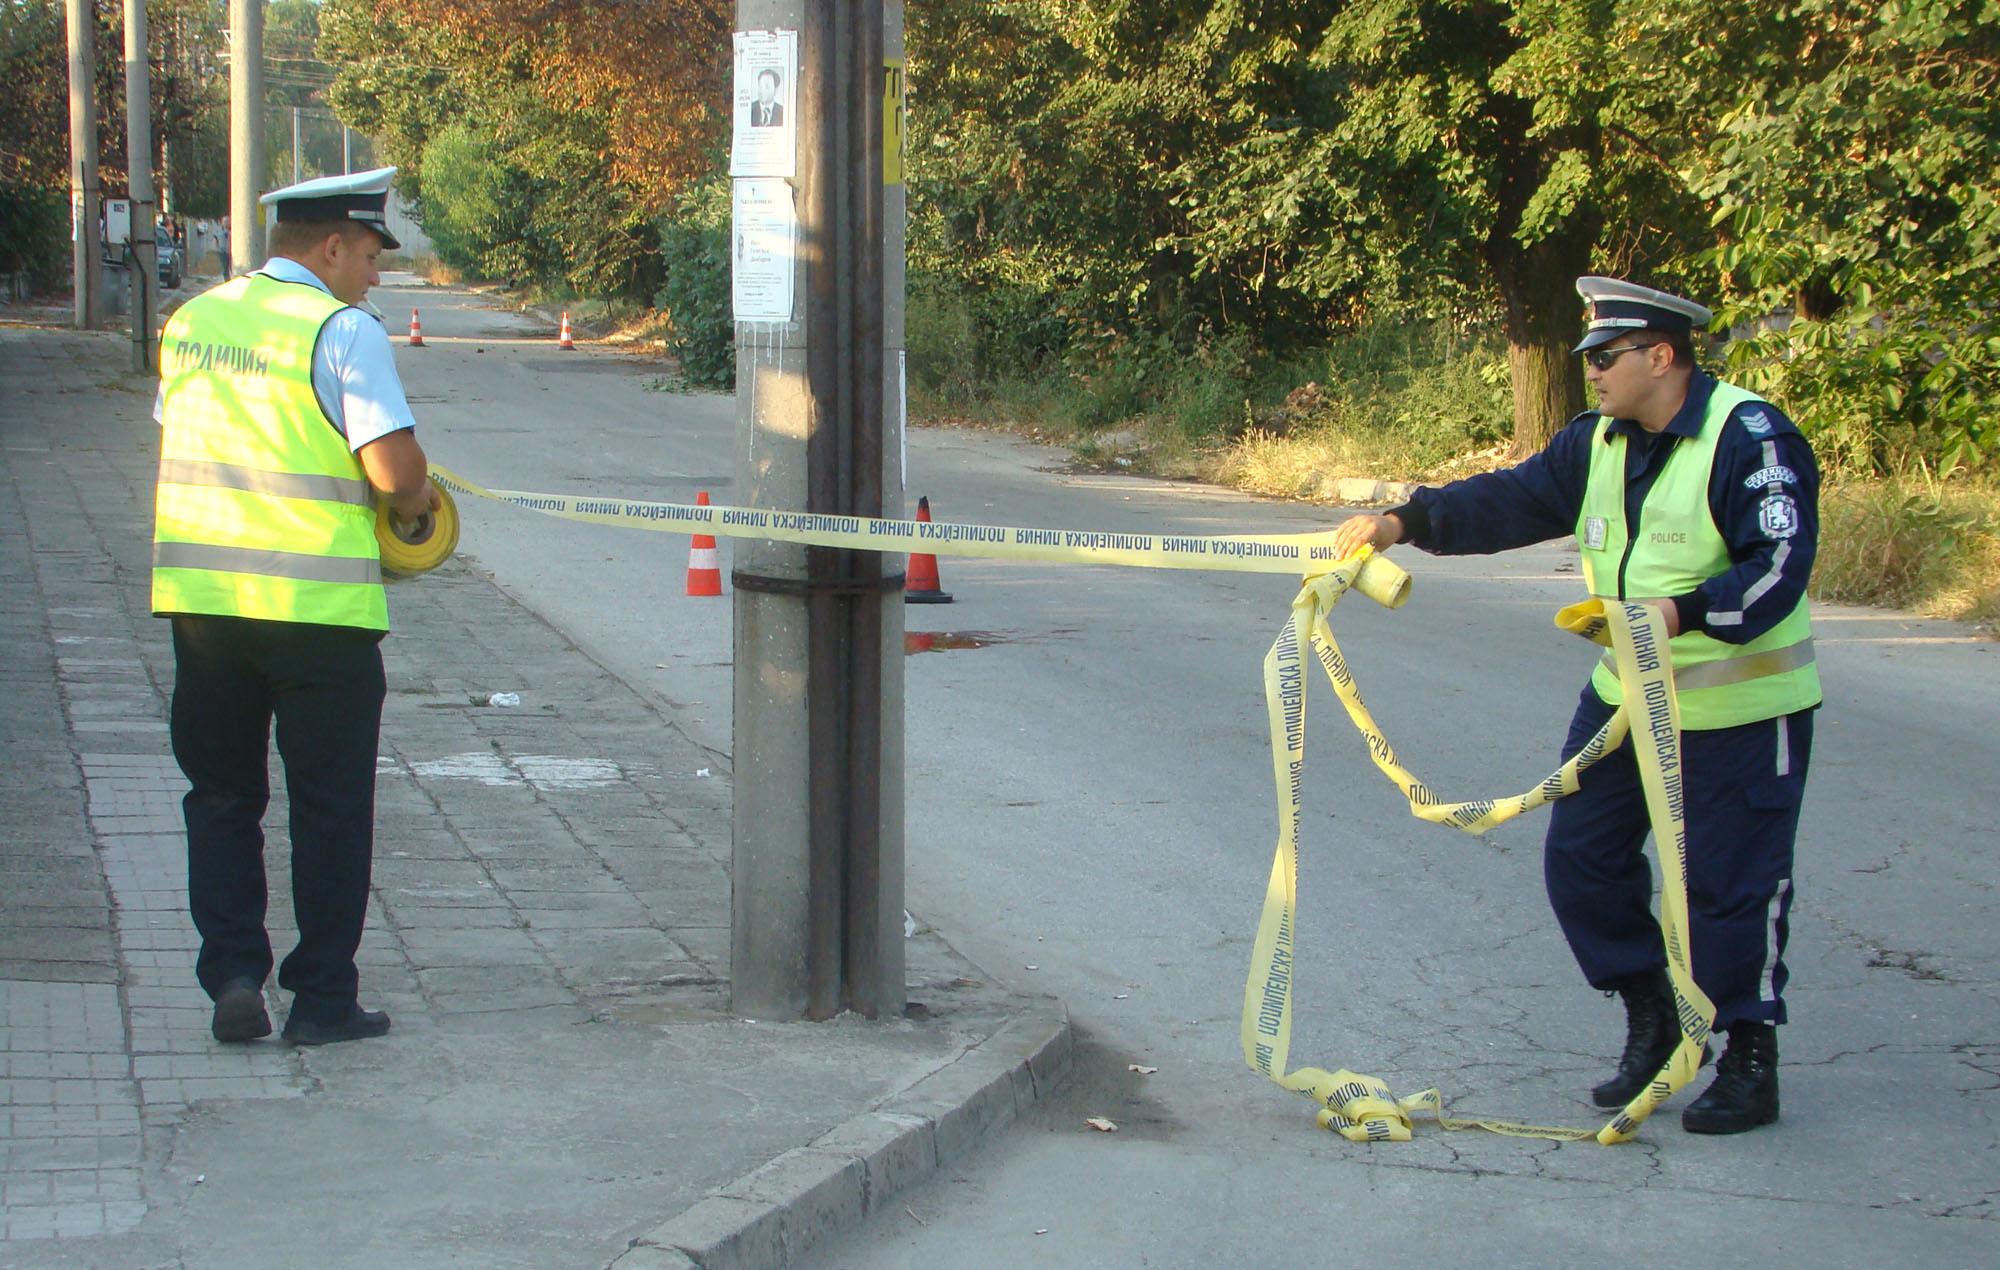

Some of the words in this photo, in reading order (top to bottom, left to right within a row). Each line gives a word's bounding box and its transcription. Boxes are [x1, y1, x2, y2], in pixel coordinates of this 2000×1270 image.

[176, 341, 268, 376] ПОЛИЦИЯ
[575, 502, 620, 515] ЛИНИЯ
[625, 504, 713, 522] ПОЛИЦЕЙСКА
[723, 510, 767, 528] ЛИНИЯ
[773, 513, 859, 533] ПОЛИЦЕЙСКА
[869, 520, 915, 537] ЛИНИЯ
[919, 523, 1005, 543] ПОЛИЦЕЙСКА
[1016, 529, 1061, 546] ЛИНИЯ
[1065, 532, 1152, 551] ПОЛИЦЕЙСКА
[1650, 533, 1687, 544] POLICE
[1162, 538, 1206, 554] ЛИНИЯ
[1212, 540, 1298, 559] ПОЛИЦЕЙСКА
[1630, 623, 1661, 673] ЛИНИЯ
[1278, 664, 1304, 752] ПОЛИЦЕЙСКА
[1643, 680, 1680, 772] ПОЛИЦЕЙСКА
[1663, 773, 1685, 823] ЛИНИЯ
